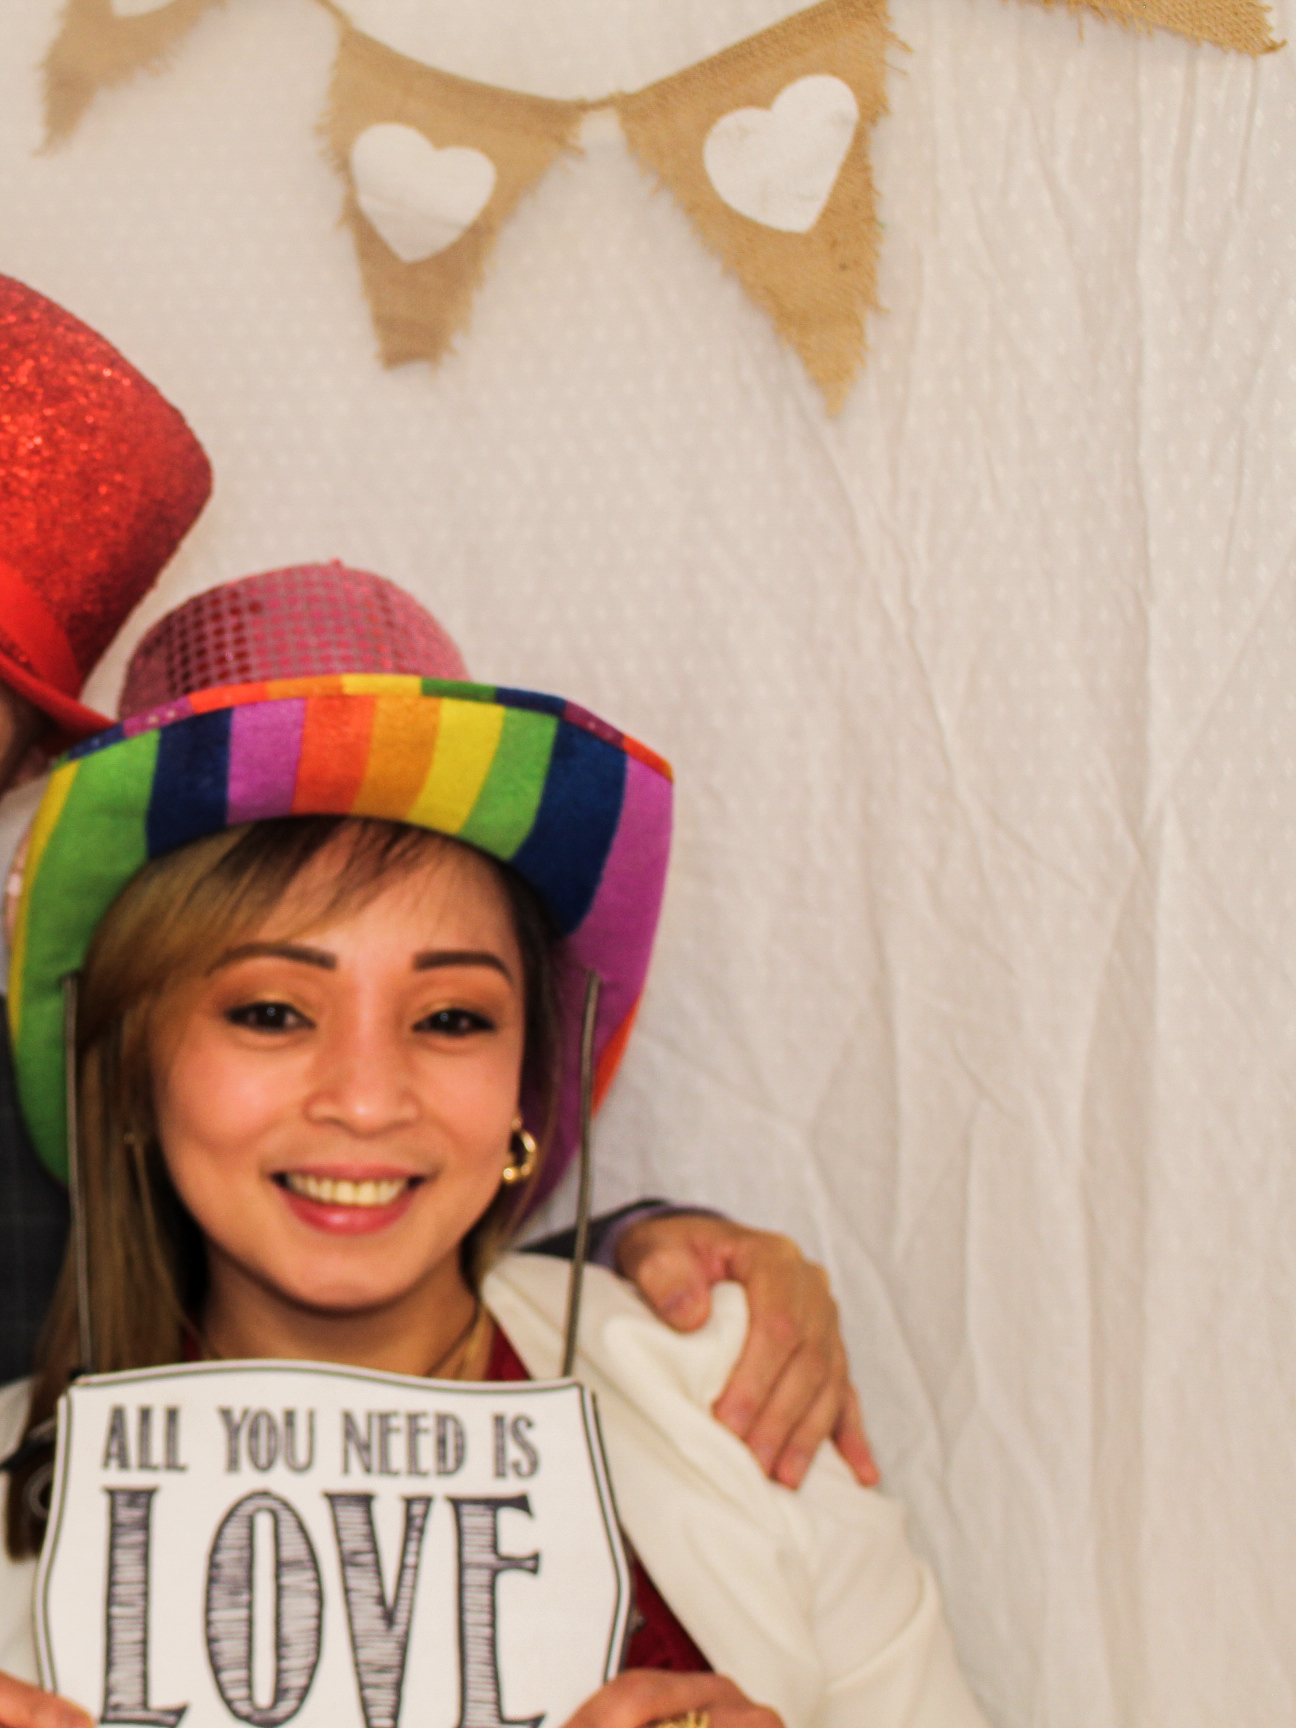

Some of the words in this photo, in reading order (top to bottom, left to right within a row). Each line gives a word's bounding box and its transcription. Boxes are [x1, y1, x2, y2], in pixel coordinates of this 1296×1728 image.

[103, 1405, 188, 1472] ALL
[218, 1407, 316, 1472] YOU
[341, 1411, 465, 1477] NEED
[492, 1413, 540, 1479] IS
[99, 1486, 548, 1728] LOVE
